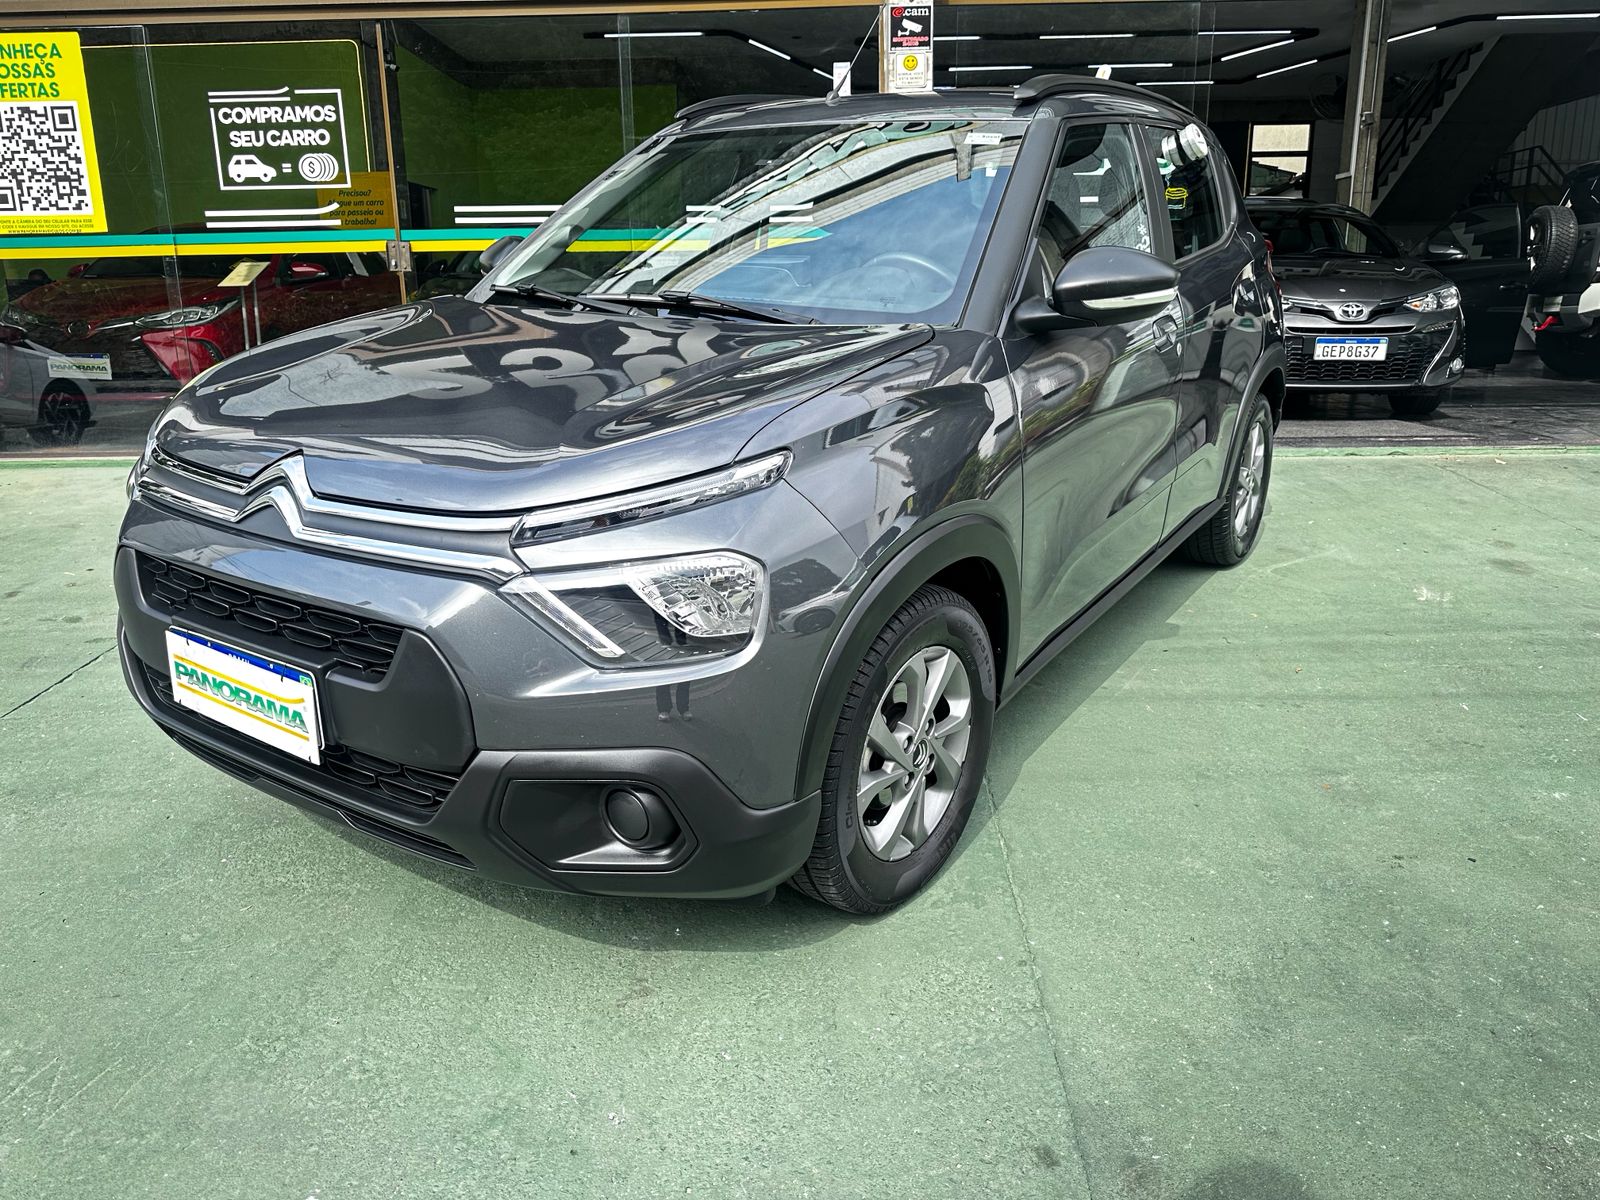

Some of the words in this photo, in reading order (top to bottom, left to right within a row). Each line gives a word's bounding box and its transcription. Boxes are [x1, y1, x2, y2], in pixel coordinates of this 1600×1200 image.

[218, 105, 337, 124] COMPRAMOS
[229, 130, 265, 147] SEU
[266, 128, 331, 146] CARRO
[347, 207, 374, 217] passeio
[1321, 345, 1379, 358] GEP8G37
[51, 363, 108, 371] PANORAMA
[174, 660, 310, 734] PANORAMA
